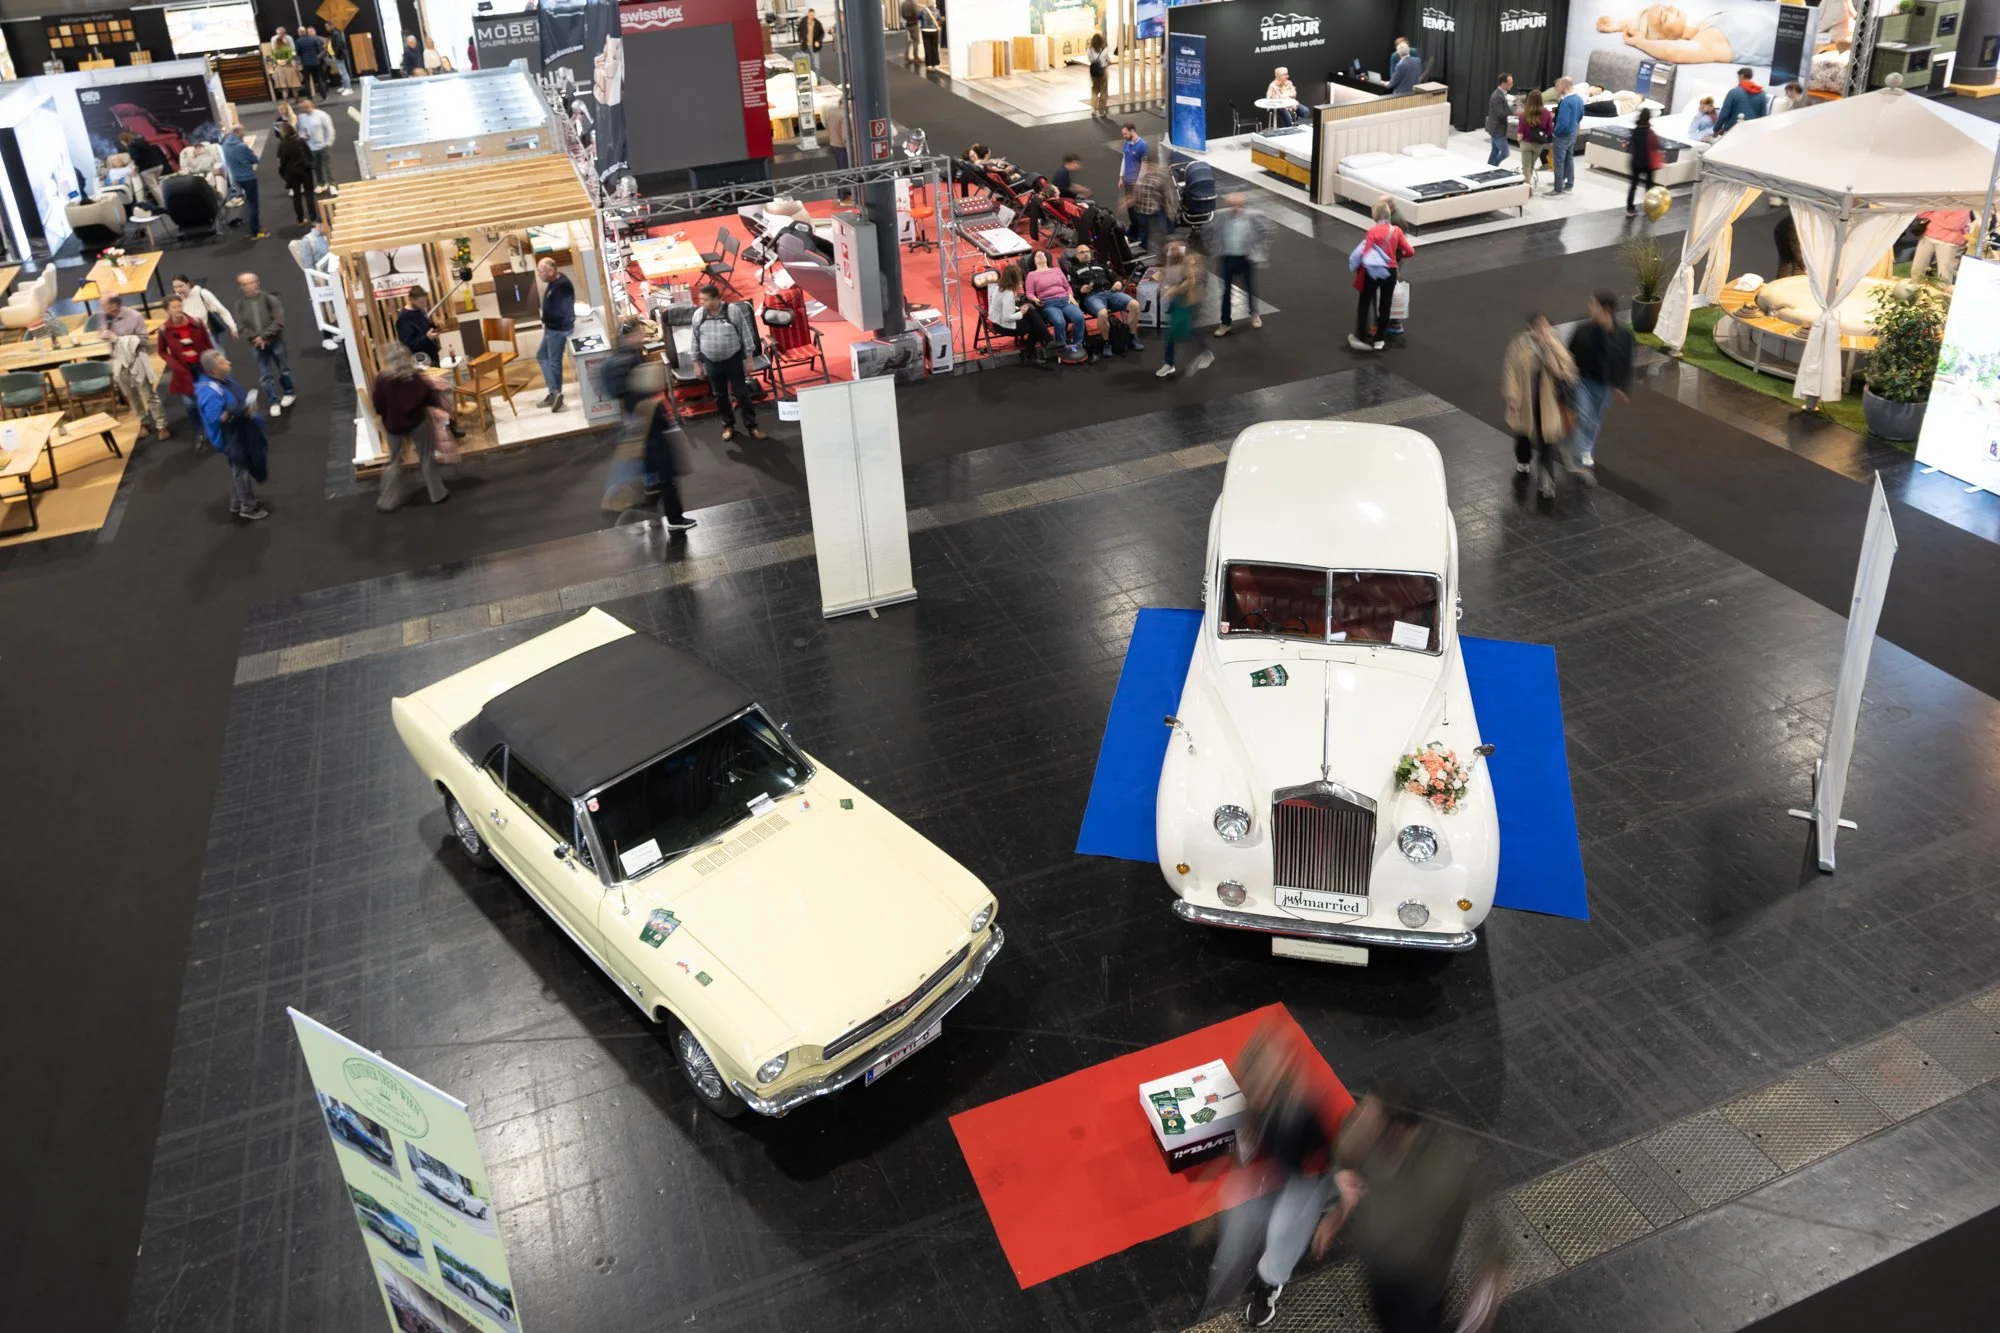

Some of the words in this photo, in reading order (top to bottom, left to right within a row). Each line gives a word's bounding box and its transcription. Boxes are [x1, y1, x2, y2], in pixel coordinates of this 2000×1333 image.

[620, 6, 682, 23] swissflex
[1261, 20, 1320, 41] TEMPUR
[1422, 16, 1455, 32] TEMPUR
[1500, 15, 1547, 32] TEMPUR
[1261, 43, 1288, 53] mattress
[1288, 41, 1299, 49] like
[1309, 38, 1326, 46] other
[1282, 890, 1304, 907] just
[1303, 898, 1360, 913] married
